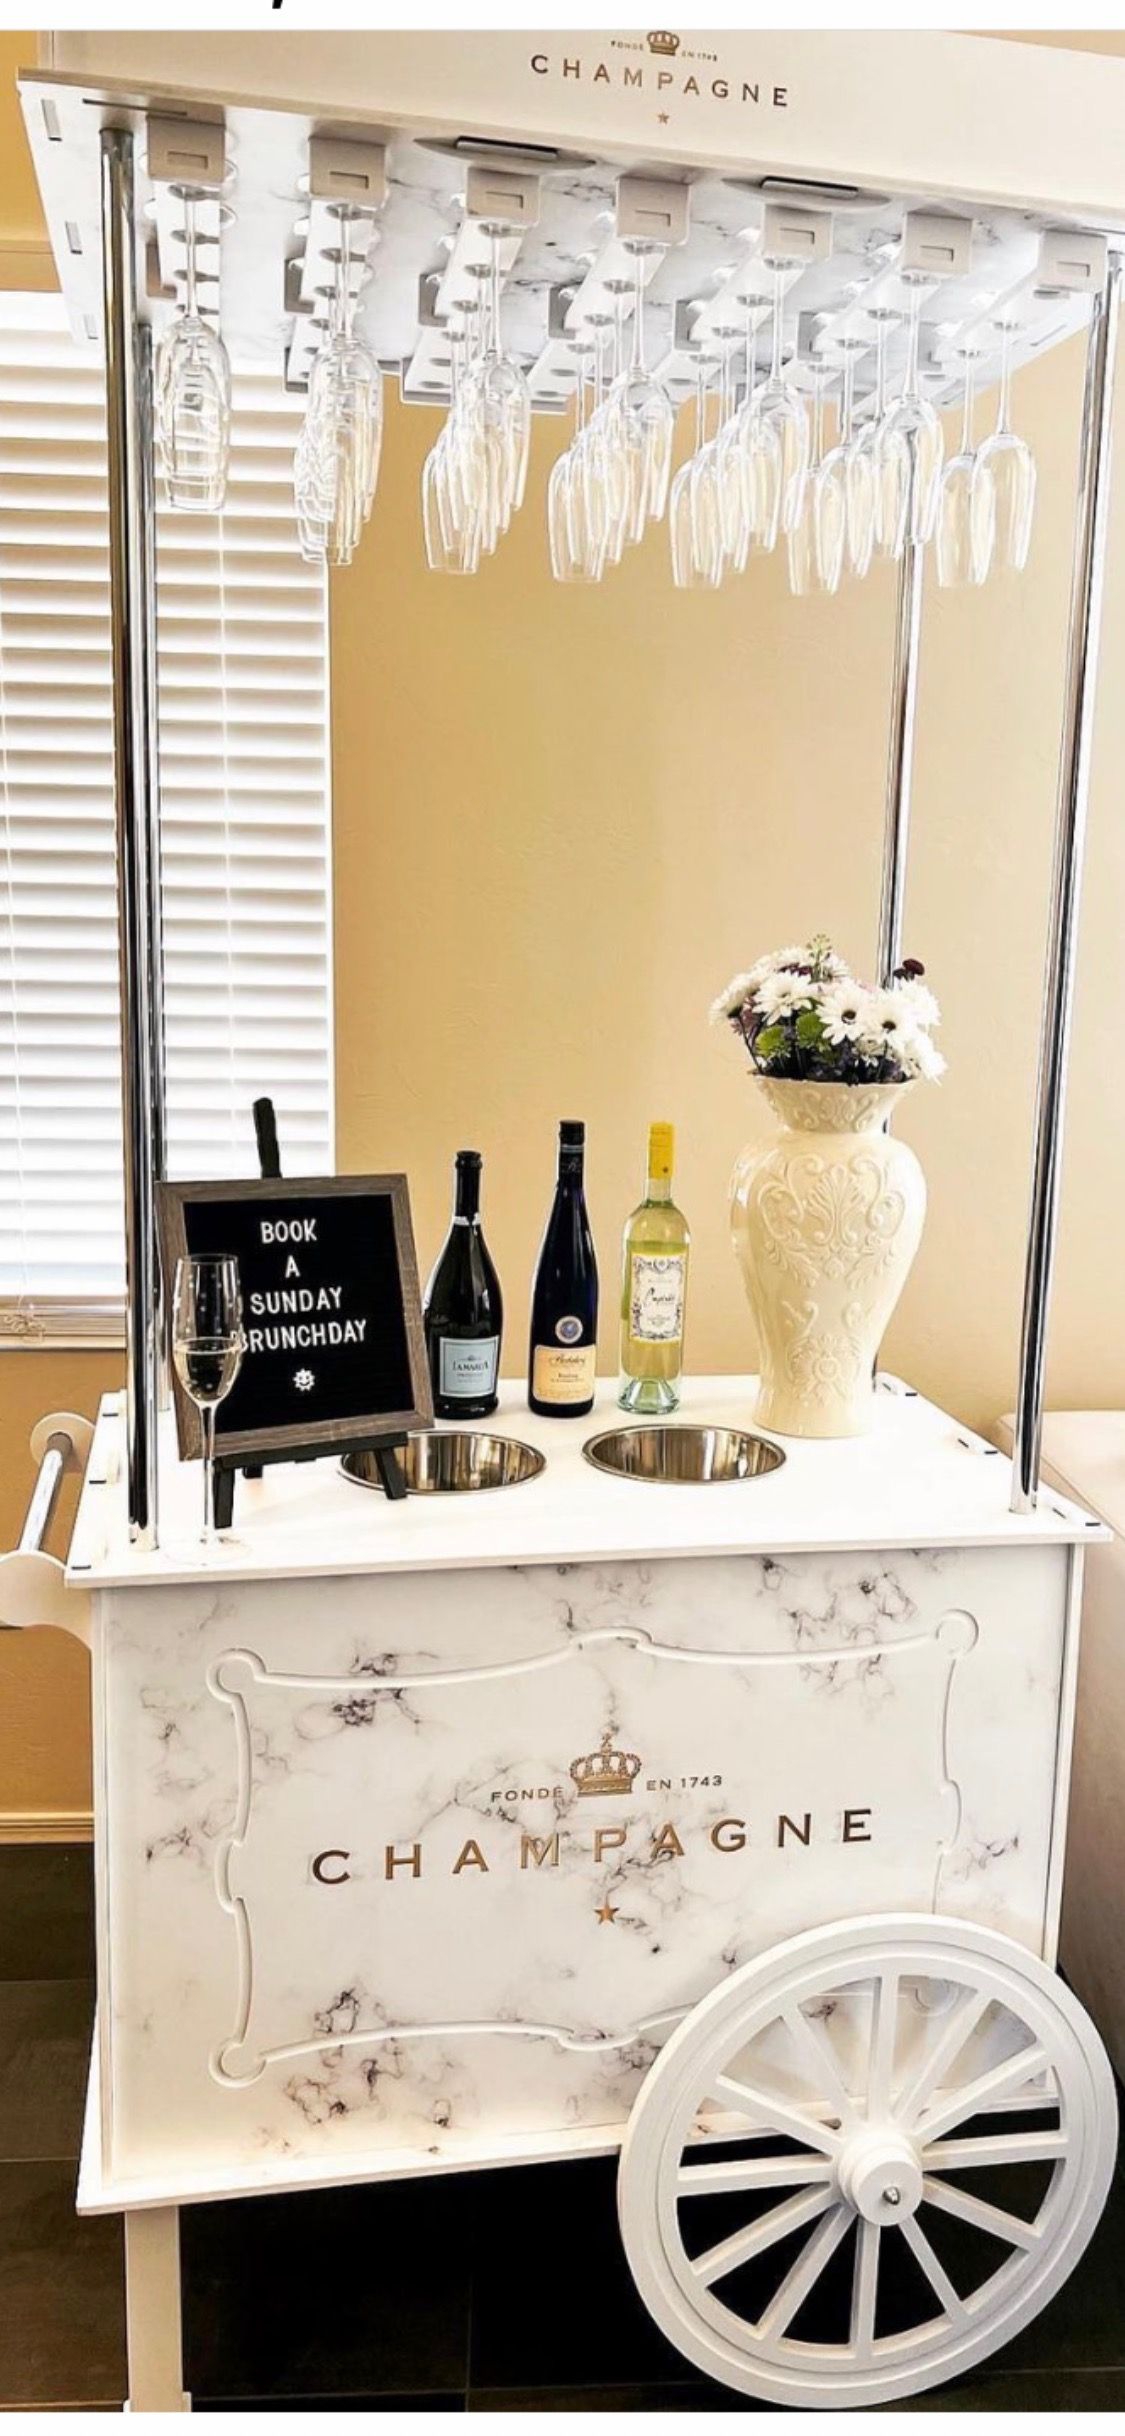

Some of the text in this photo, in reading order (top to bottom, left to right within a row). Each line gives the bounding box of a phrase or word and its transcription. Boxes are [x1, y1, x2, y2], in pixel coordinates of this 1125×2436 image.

[530, 55, 788, 107] CHAMPAGNE
[260, 1218, 317, 1244] BOOK
[285, 1254, 301, 1278] A
[250, 1286, 342, 1315] SUNDAY
[646, 1779, 672, 1791] EN
[680, 1775, 724, 1789] 1743
[312, 1808, 872, 1885] CHAMPAGNE
